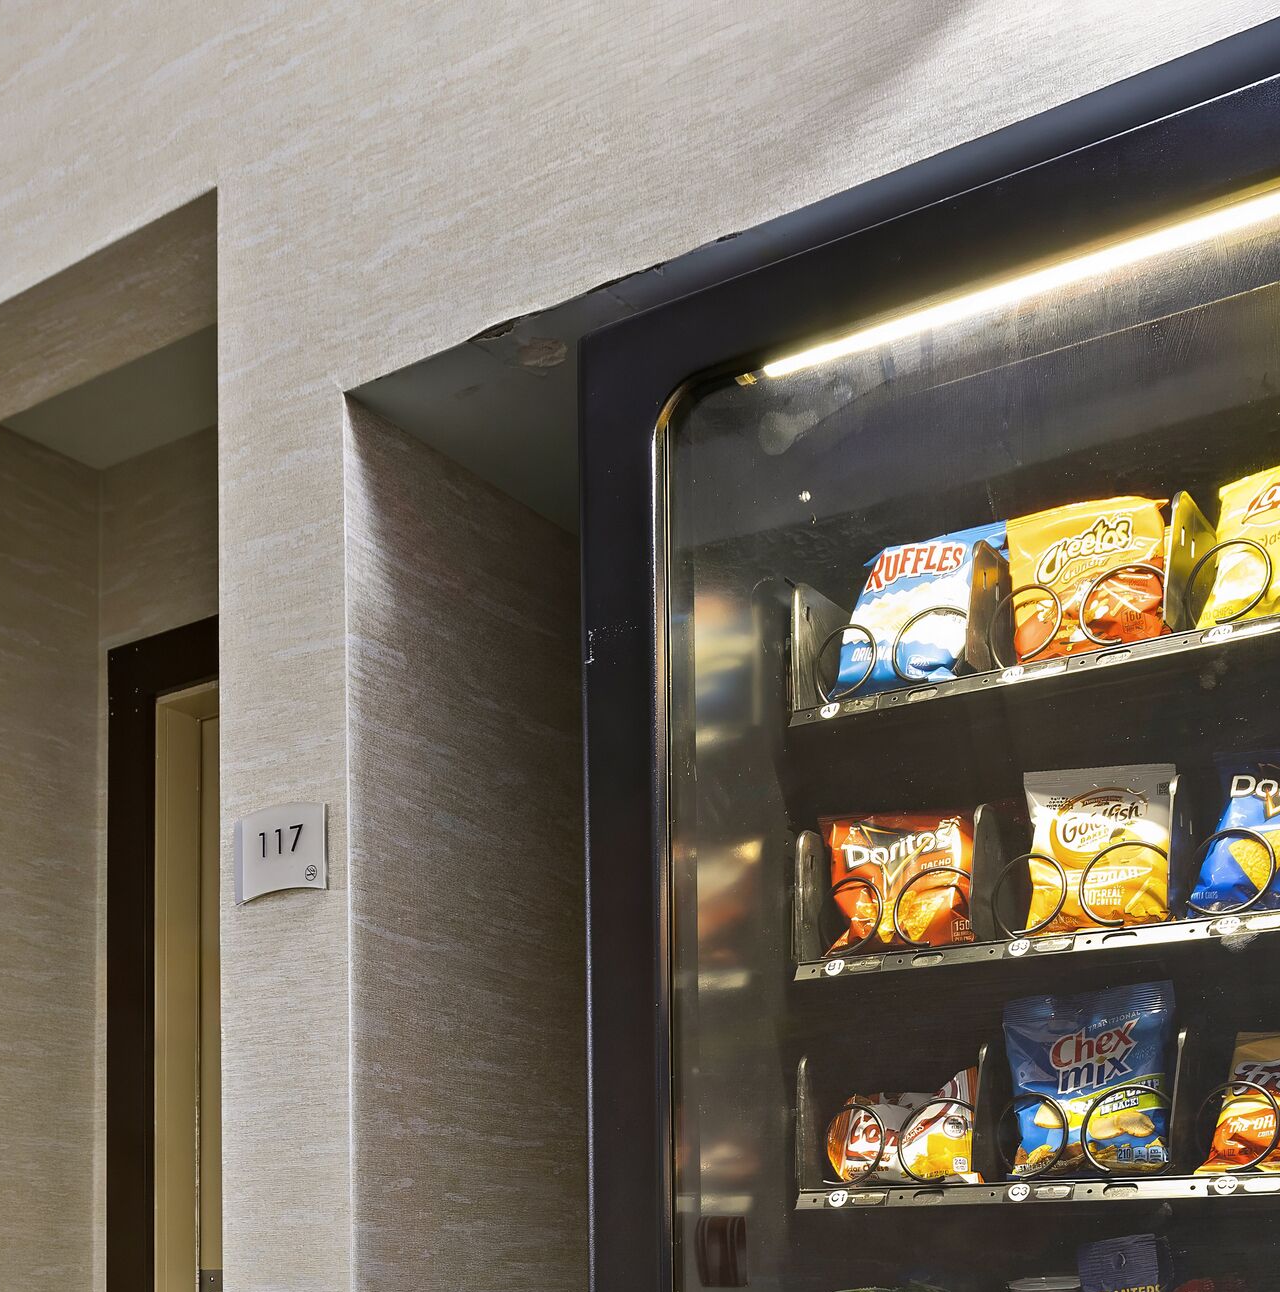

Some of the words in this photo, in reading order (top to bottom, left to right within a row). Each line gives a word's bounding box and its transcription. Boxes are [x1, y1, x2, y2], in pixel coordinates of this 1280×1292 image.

[865, 546, 963, 591] RUFFLES
[1037, 518, 1132, 584] Cheetos
[851, 646, 893, 662] ORIGNA
[258, 823, 304, 858] 117
[841, 826, 954, 868] Doritos
[954, 919, 970, 931] 150
[1088, 1011, 1141, 1032] TRADITIONAL
[1052, 1017, 1141, 1068] Chex
[1059, 1056, 1131, 1094] mix
[1118, 1148, 1131, 1159] 210
[1012, 1187, 1027, 1196] C3
